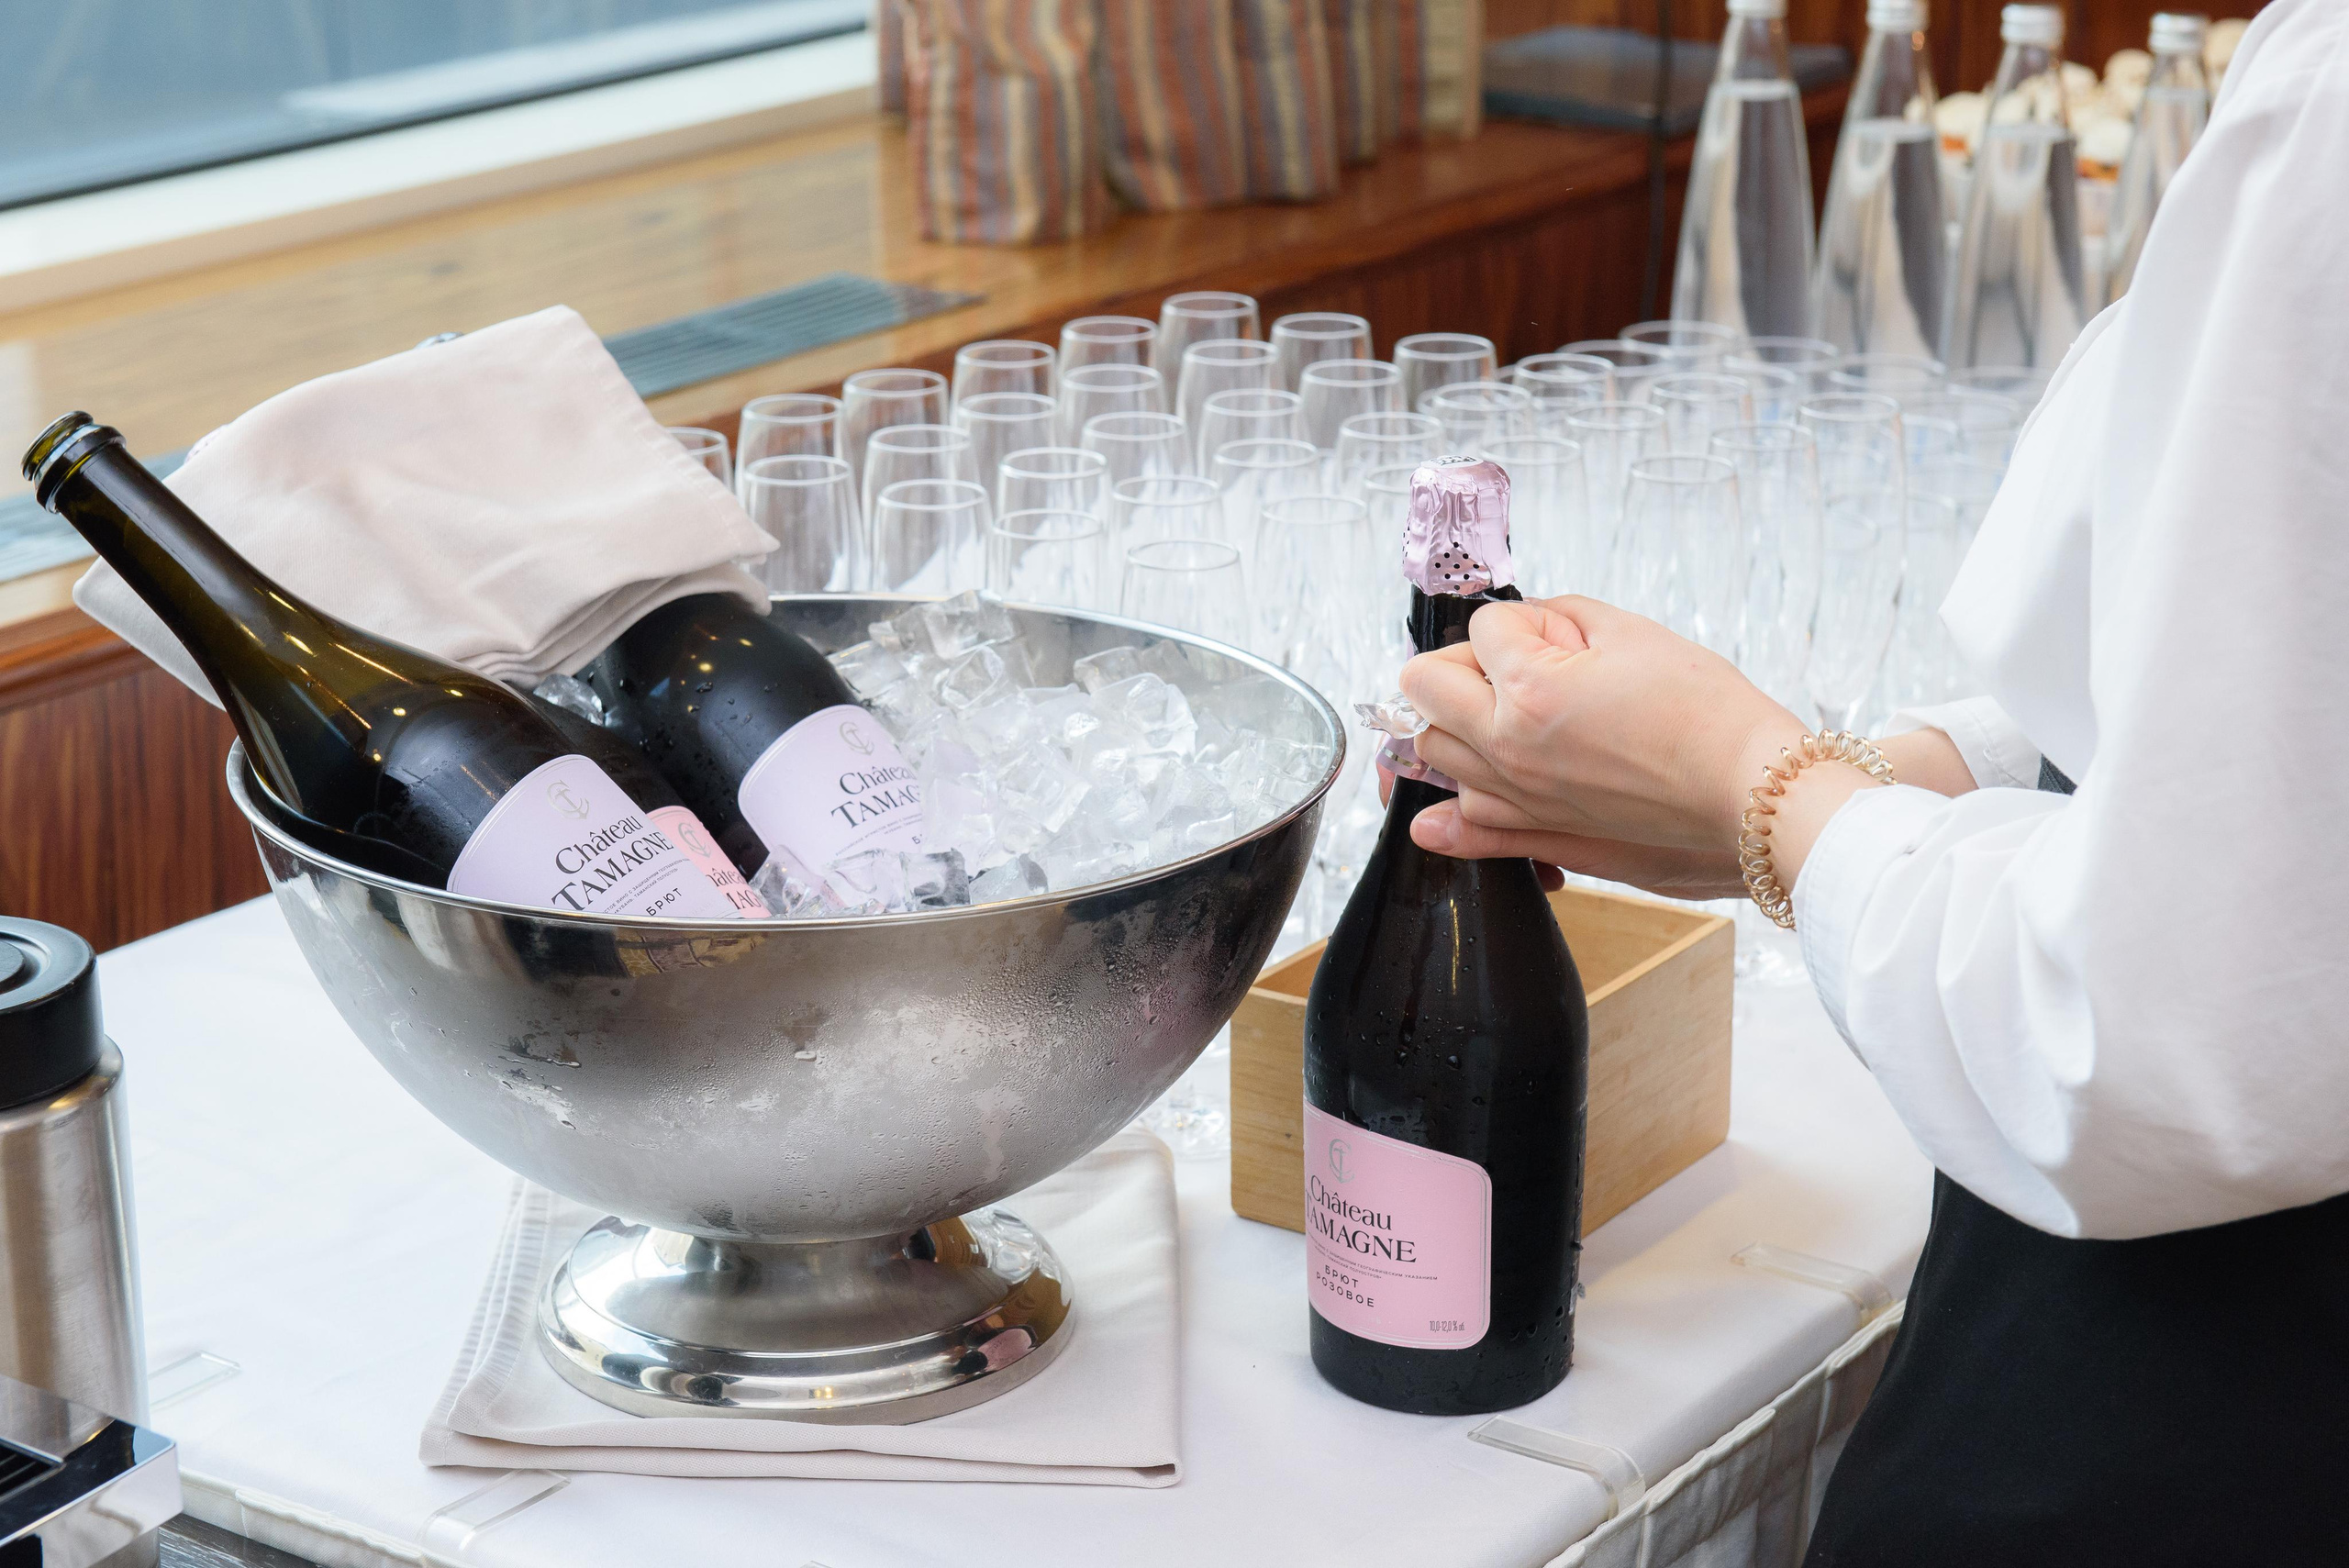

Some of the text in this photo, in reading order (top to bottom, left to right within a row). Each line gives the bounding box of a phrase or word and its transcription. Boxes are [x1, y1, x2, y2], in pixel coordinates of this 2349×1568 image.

[830, 784, 921, 828] TAMAG
[555, 816, 643, 874] Château
[551, 831, 674, 911] TAMAGNE
[645, 887, 682, 917] БРЮТ
[1306, 1189, 1417, 1263] TAMAGNE
[1310, 1174, 1392, 1230] Château
[1316, 1271, 1375, 1307] РОЗОВОЕ
[1324, 1264, 1359, 1288] БРЮТ
